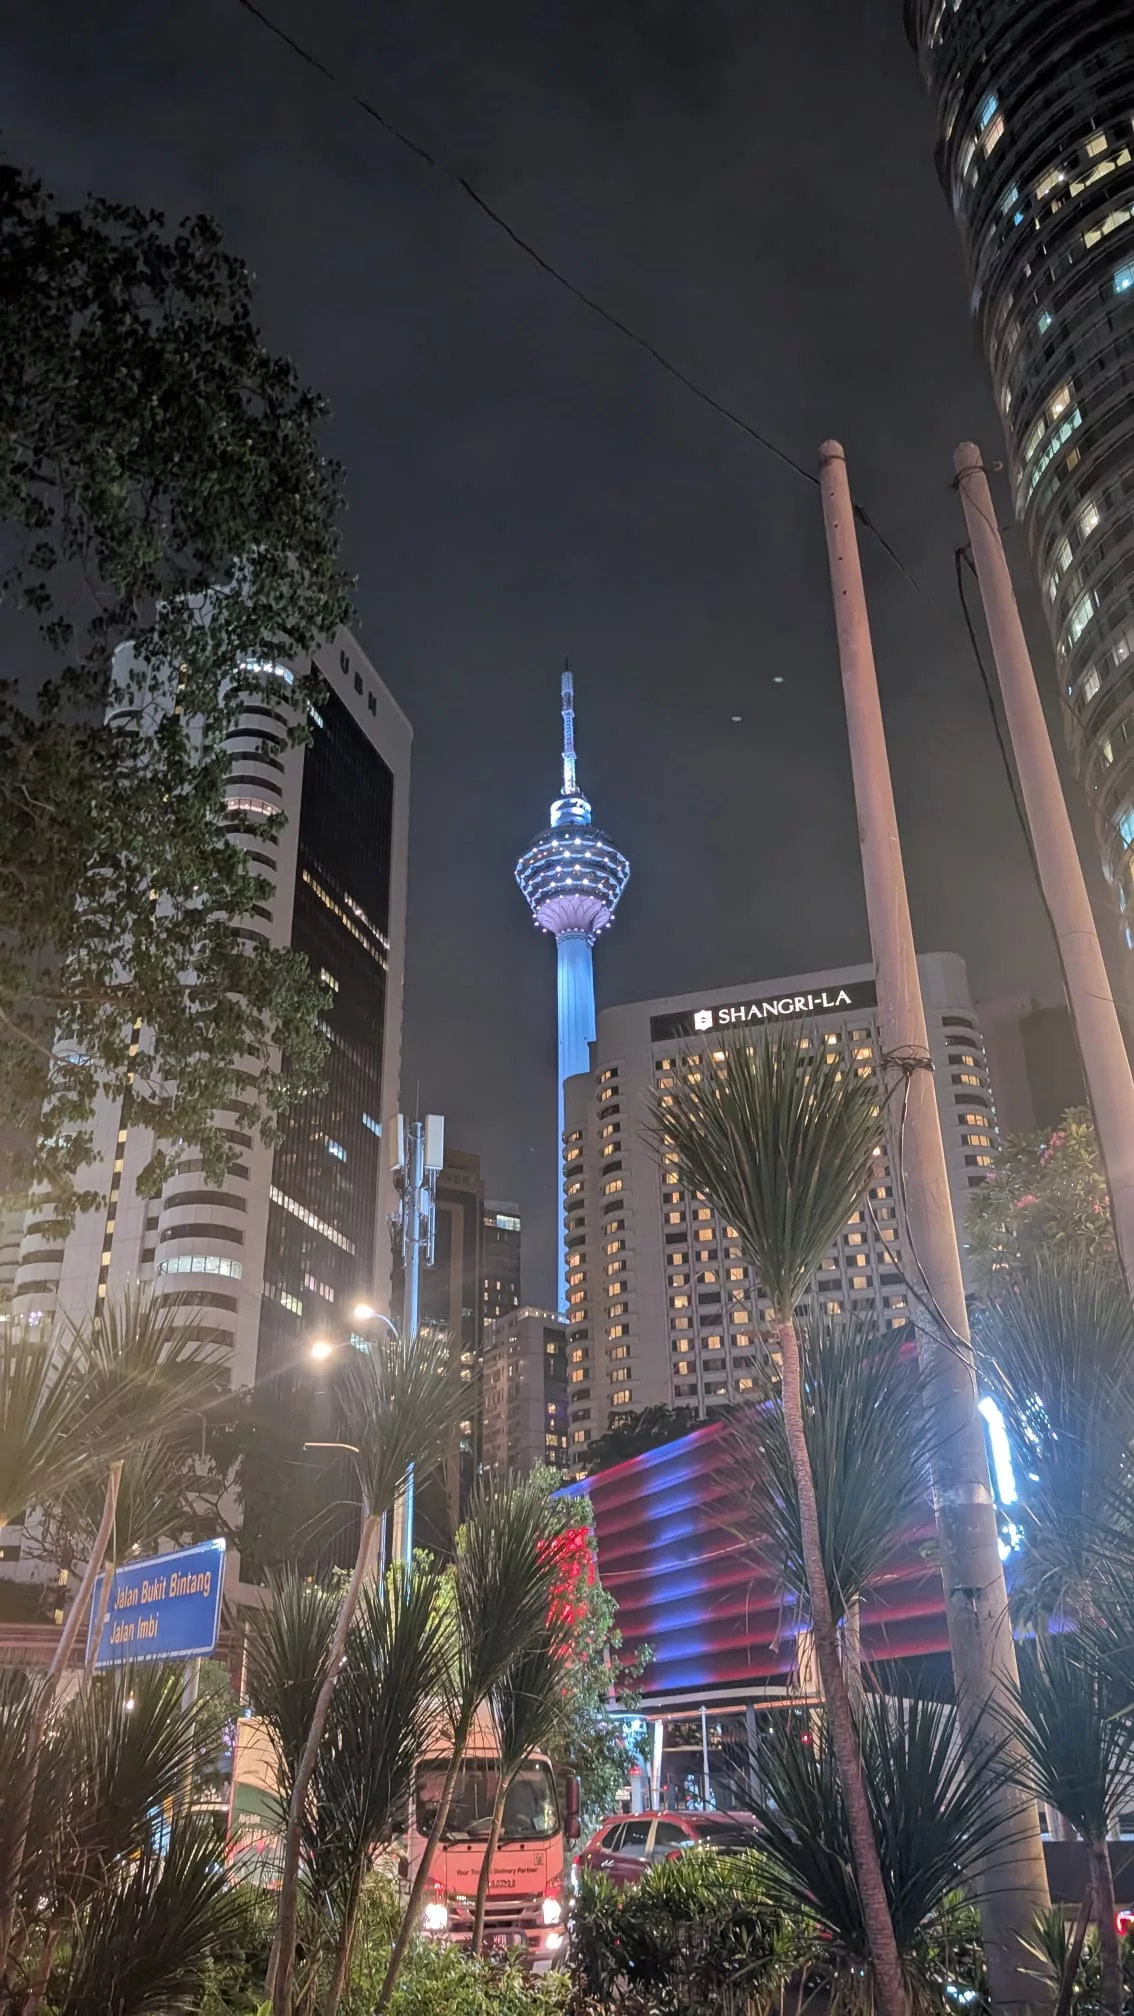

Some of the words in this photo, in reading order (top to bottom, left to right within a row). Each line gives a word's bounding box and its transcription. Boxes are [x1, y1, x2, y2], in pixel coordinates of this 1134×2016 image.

[718, 990, 851, 1024] SHANGRI-LA
[115, 1585, 138, 1610] Jalan
[140, 1576, 166, 1604] Bukit
[169, 1571, 211, 1597] Bintang
[110, 1618, 134, 1644] Jalan
[136, 1613, 159, 1640] Imbi
